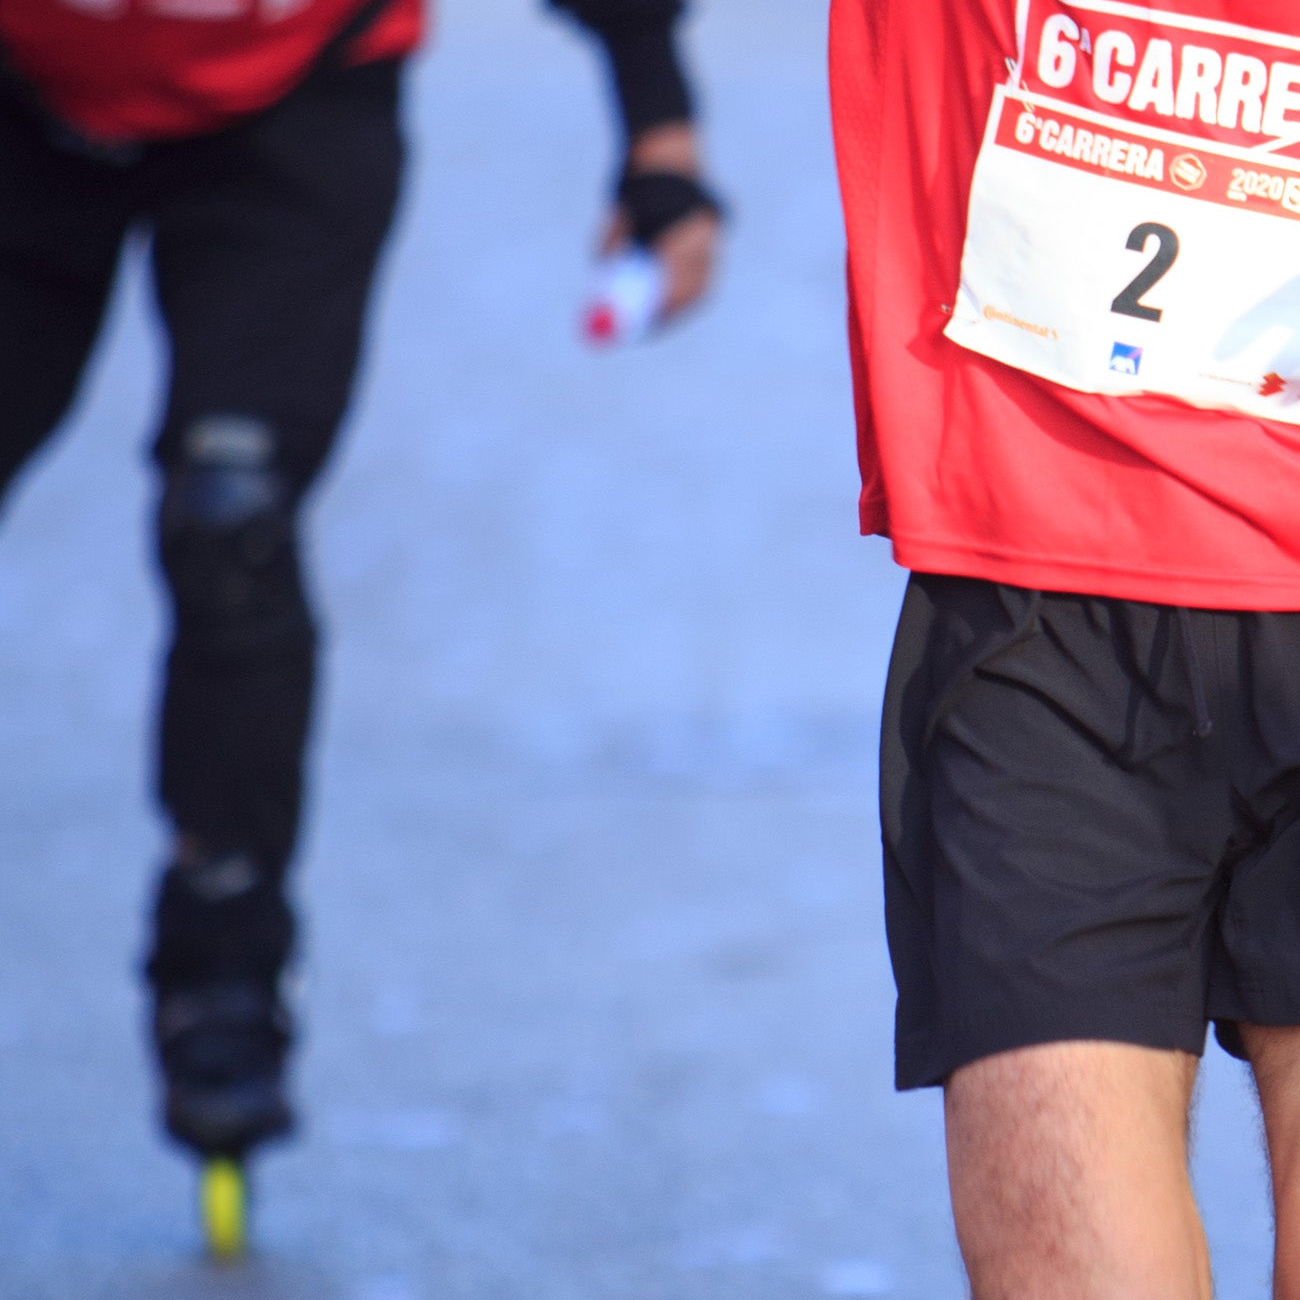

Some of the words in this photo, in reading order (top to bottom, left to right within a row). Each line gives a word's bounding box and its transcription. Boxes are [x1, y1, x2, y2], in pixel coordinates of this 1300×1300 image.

[1039, 119, 1164, 182] CARRERA
[1228, 167, 1285, 201] 2020
[1110, 221, 1181, 324] 2
